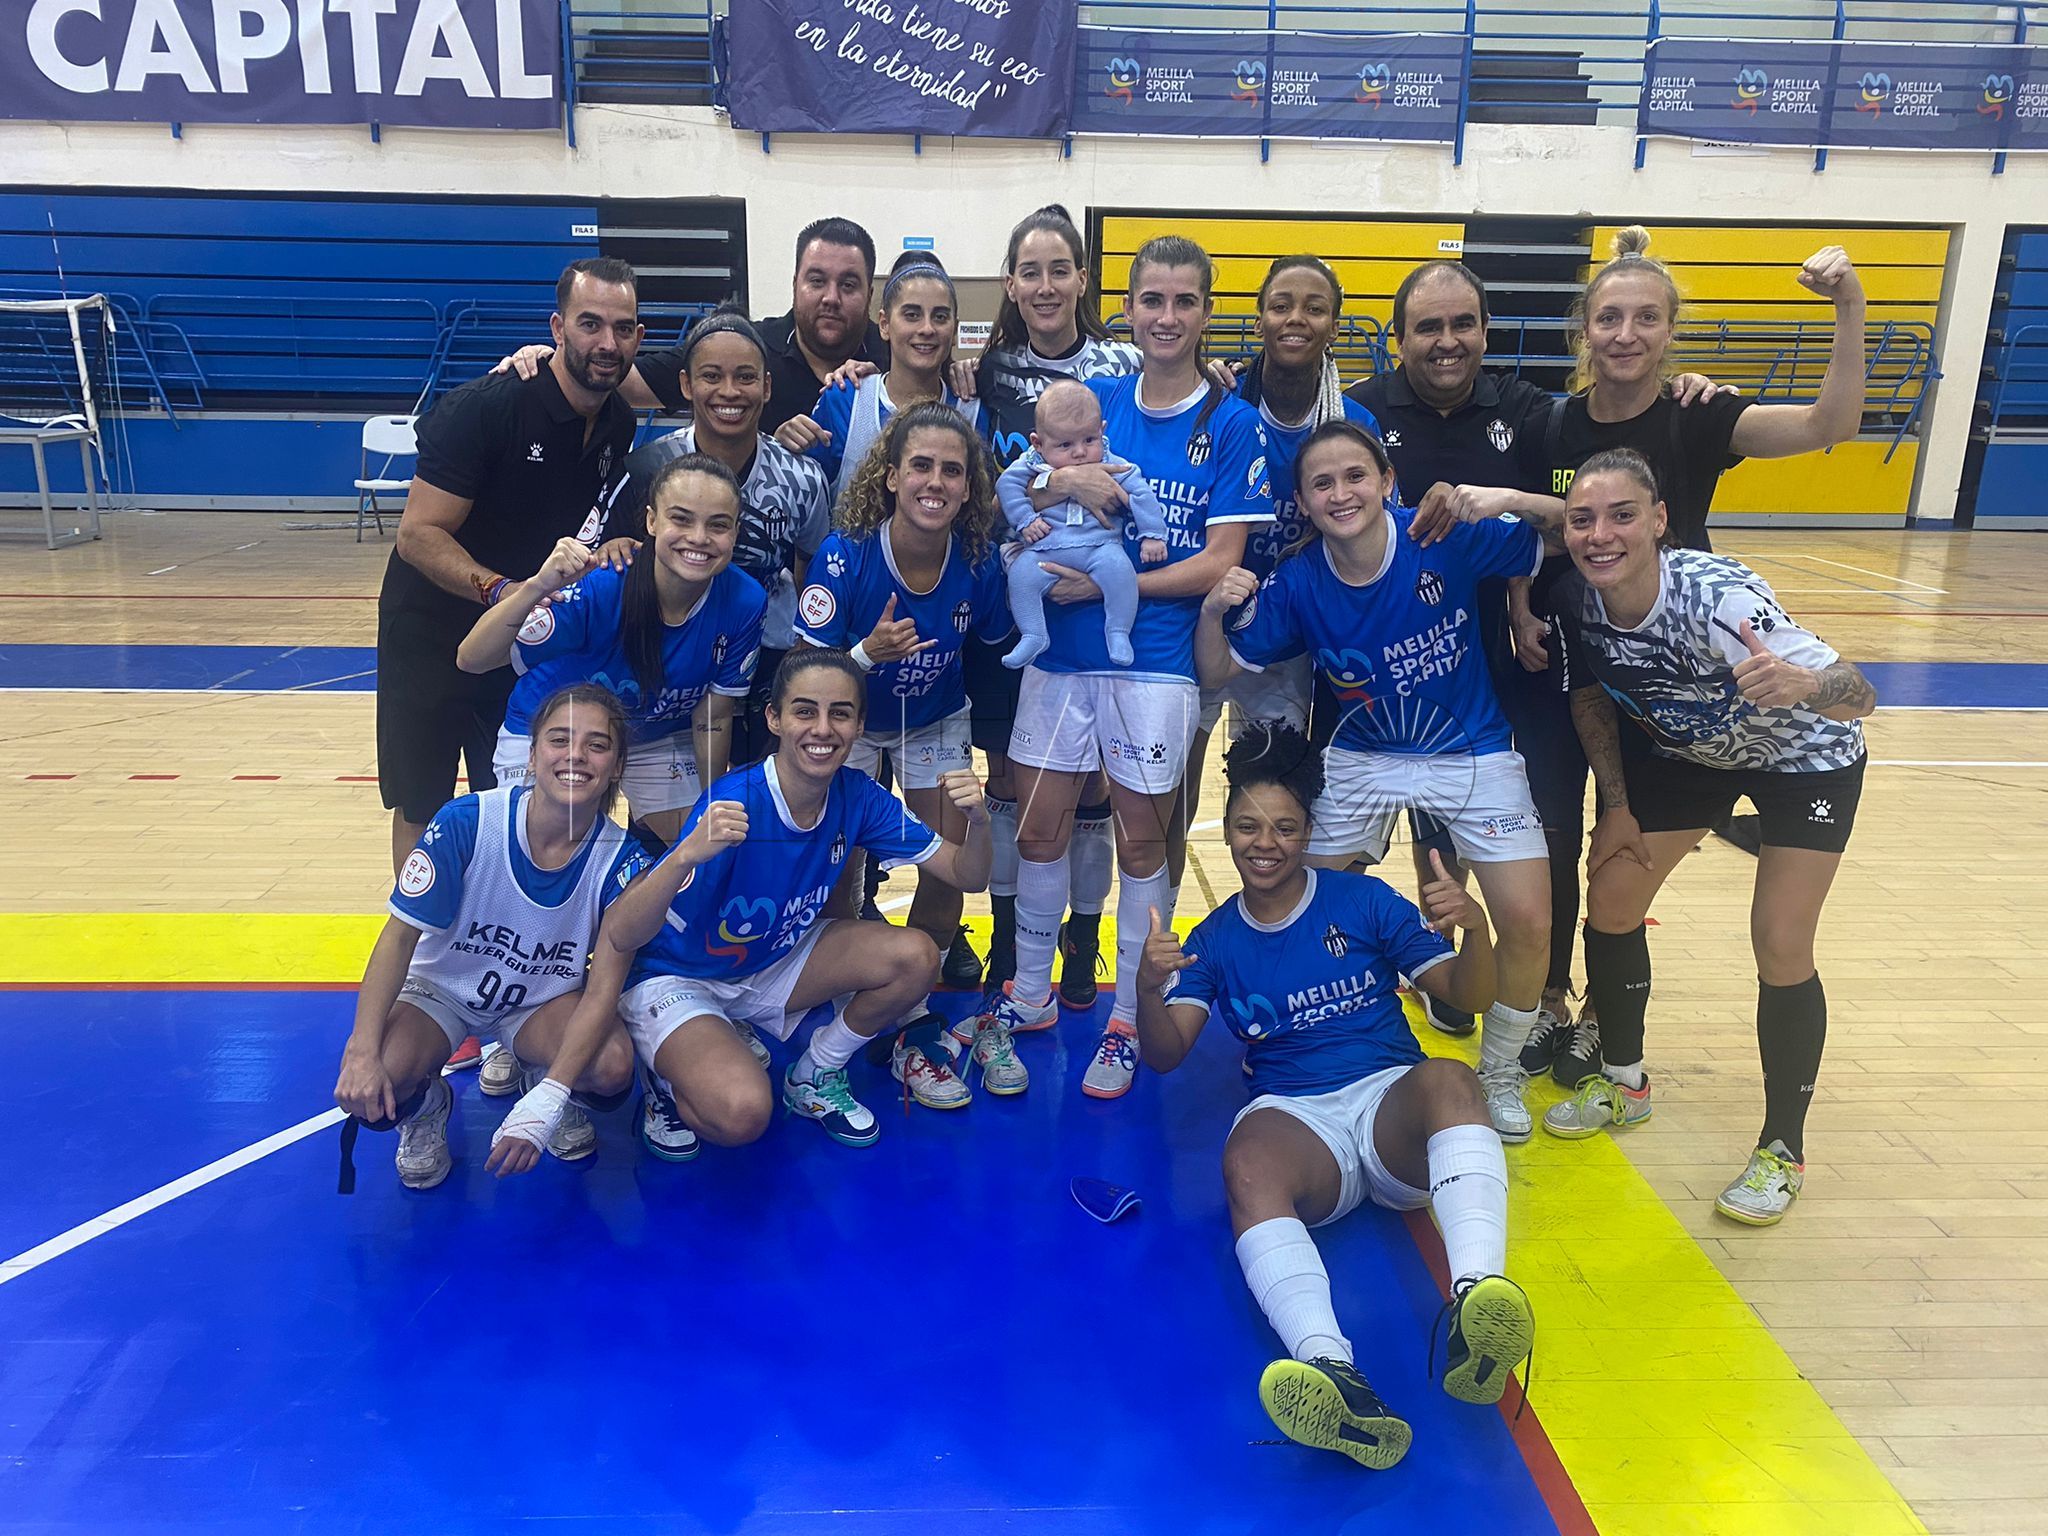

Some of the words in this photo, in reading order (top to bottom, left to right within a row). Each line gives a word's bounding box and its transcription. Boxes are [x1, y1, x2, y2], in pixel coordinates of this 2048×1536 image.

[26, 0, 553, 98] CAPITAL
[795, 21, 830, 51] en
[837, 21, 867, 64] la
[903, 5, 964, 52] tiene
[969, 42, 995, 66] su
[1001, 58, 1045, 85] eco
[1146, 67, 1194, 80] MELILLA
[1272, 70, 1319, 83] MELILLA
[1395, 72, 1443, 85] MELILLA
[1146, 79, 1186, 92] SPORT
[1271, 82, 1310, 95] SPORT
[1652, 76, 1696, 89] MELILLA
[1772, 78, 1820, 90] MELILLA
[1895, 81, 1943, 94] MELILLA
[1145, 91, 1193, 103] CAPITAL
[1394, 84, 1434, 97] SPORT
[1650, 88, 1687, 100] SPORT
[1771, 90, 1811, 102] SPORT
[1270, 94, 1318, 107] CAPITAL
[1393, 96, 1441, 109] CAPITAL
[1649, 99, 1694, 112] CAPITAL
[1894, 93, 1934, 105] SPORT
[2017, 95, 2048, 106] SPOR
[1770, 102, 1818, 114] CAPITAL
[1893, 105, 1940, 117] CAPITAL
[2015, 107, 2048, 117] CAPIT
[1553, 469, 1575, 493] BR
[1147, 478, 1209, 506] ELILLA
[1383, 607, 1468, 663] MELILLA
[1389, 632, 1448, 679] SPORT
[896, 667, 946, 684] SPO
[1395, 641, 1468, 697] CAPITAL
[659, 683, 708, 701] MELI
[1499, 814, 1525, 824] MELILLA
[1501, 820, 1522, 829] SPORT
[1808, 815, 1835, 824] KELME
[1502, 824, 1529, 834] CAPITAL
[468, 921, 578, 962] KELME
[449, 941, 506, 961] NEVER
[504, 956, 543, 976] GIVE
[1287, 969, 1377, 1013] MELILLA
